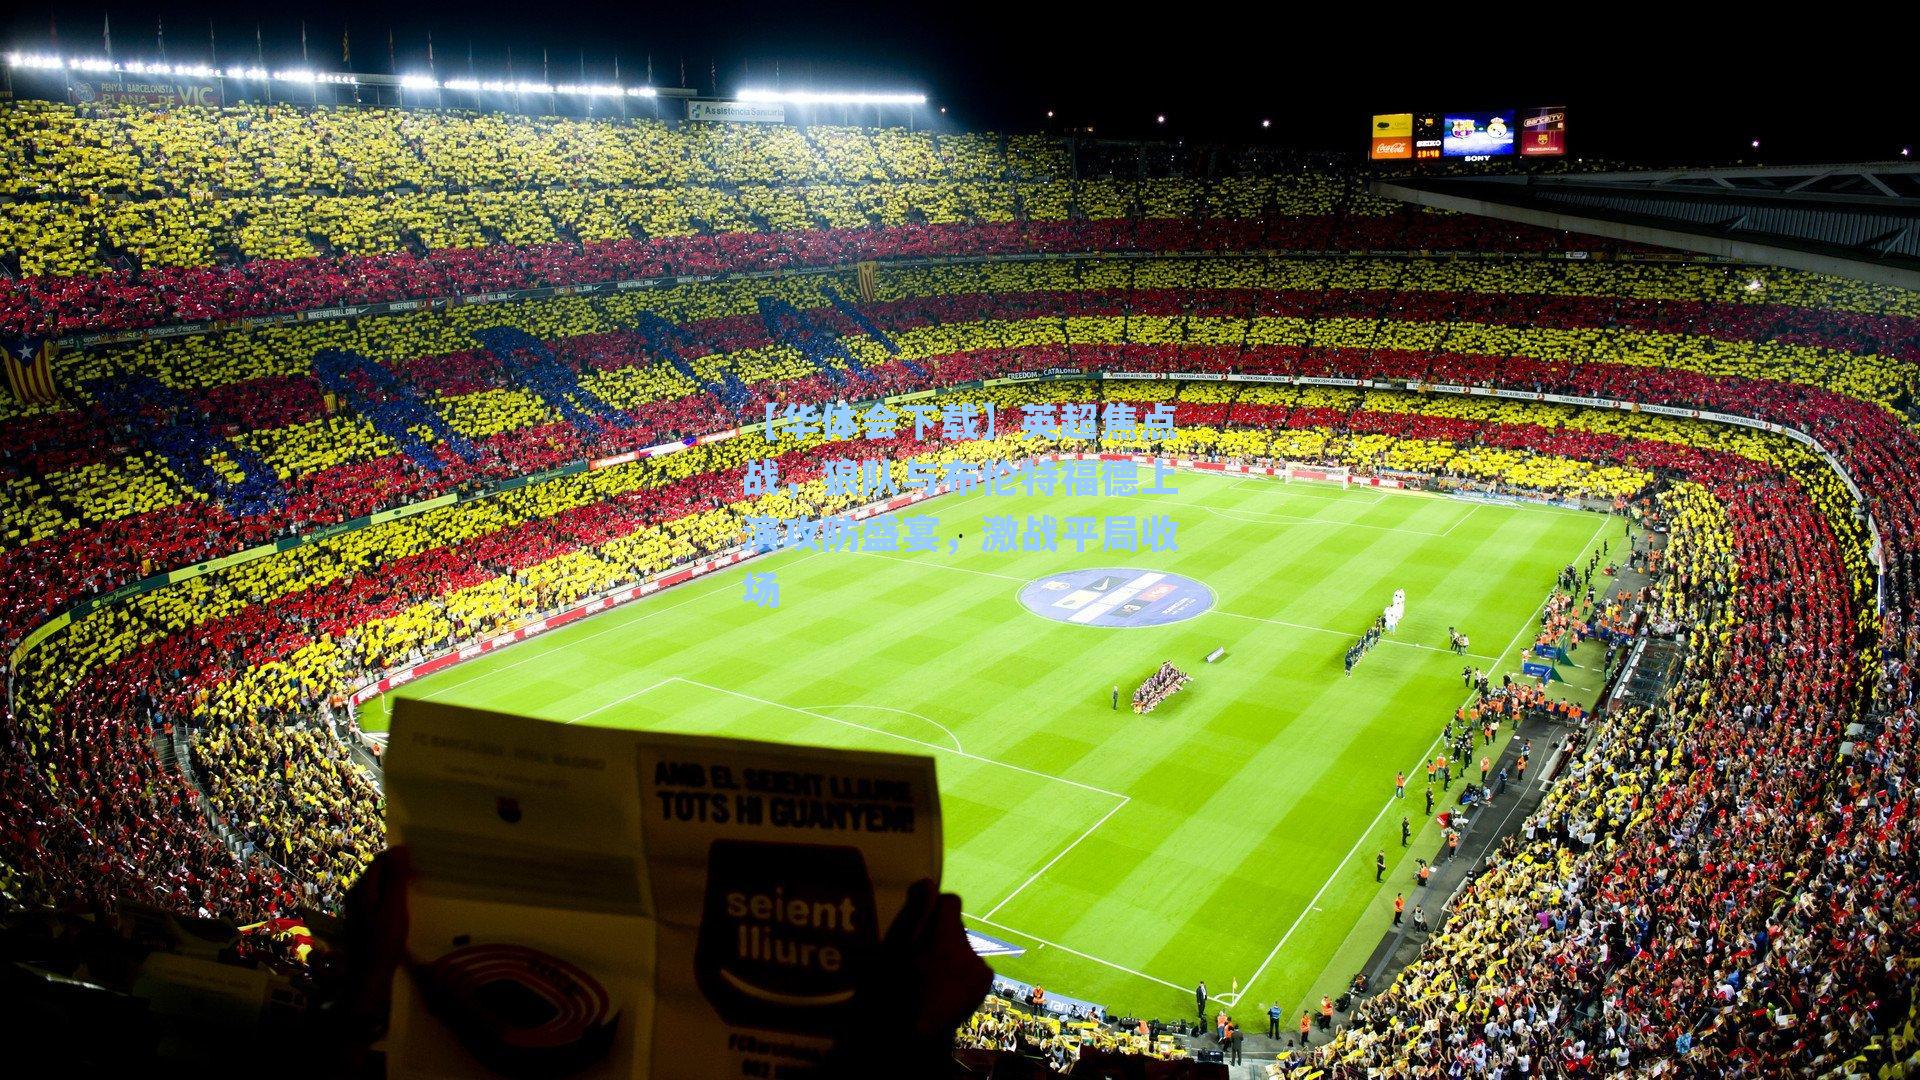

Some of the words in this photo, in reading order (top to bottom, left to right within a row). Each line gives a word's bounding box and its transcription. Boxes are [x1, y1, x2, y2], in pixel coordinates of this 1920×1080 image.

[102, 83, 123, 92] PENYA
[127, 84, 174, 93] BARCELONISTA
[177, 85, 214, 105] VIC
[308, 308, 357, 319] NIKEFOOTBALL.COM
[1043, 368, 1080, 376] CATALONIA
[1715, 414, 1740, 422] TURKISH
[1739, 419, 1763, 428] AIRLINES
[655, 761, 706, 788] AMB
[711, 765, 739, 790] EL
[744, 768, 822, 797] SEIENT
[657, 790, 730, 823] TOTS
[735, 796, 763, 825] HI
[727, 884, 855, 932] seient
[738, 923, 842, 972] lliure
